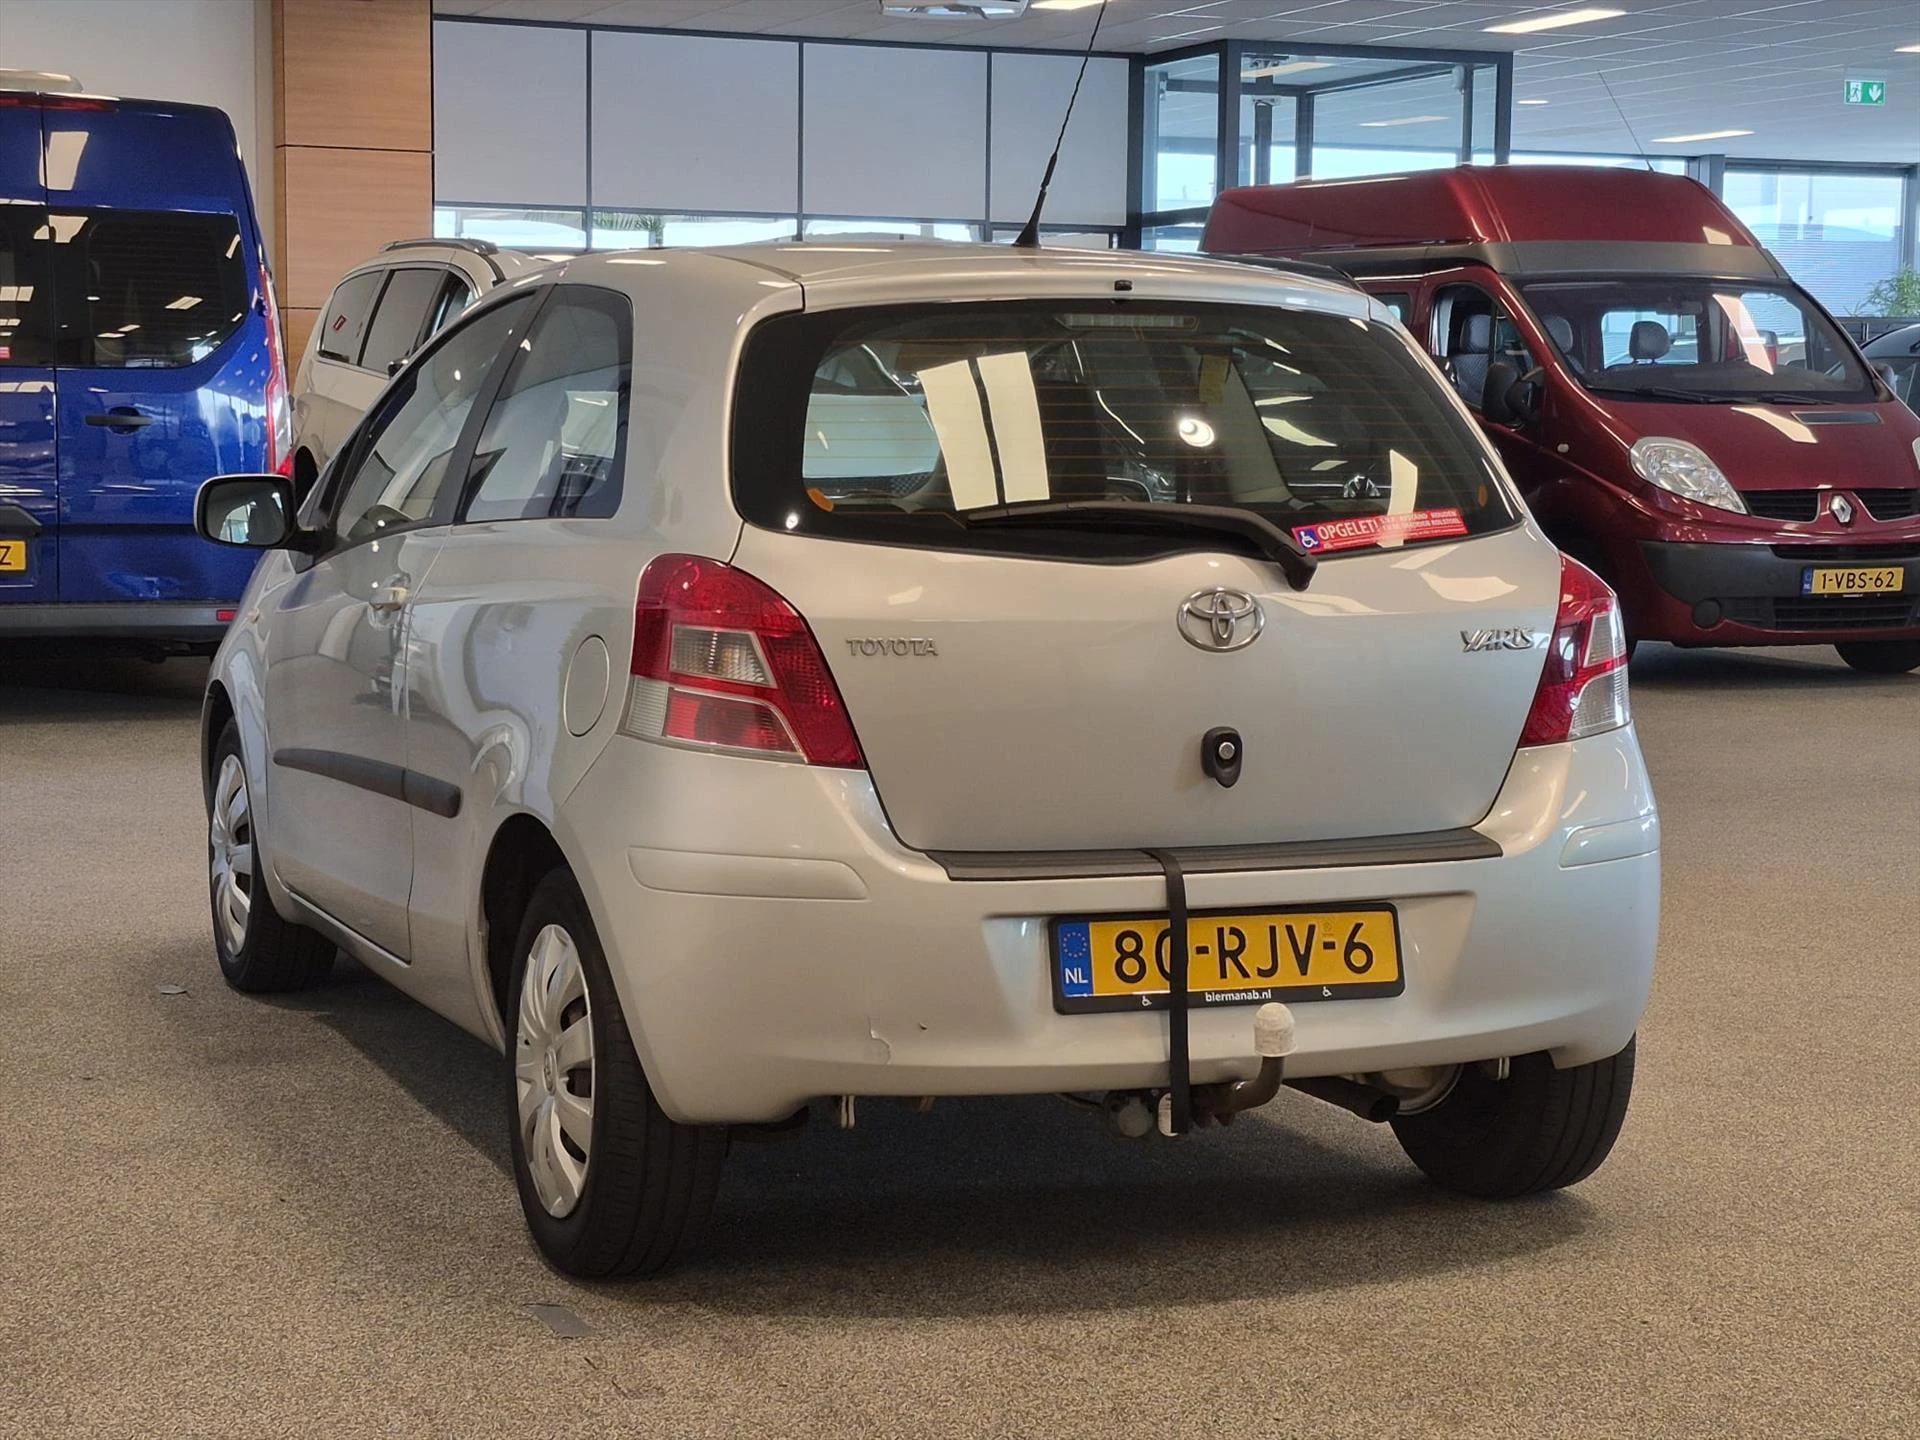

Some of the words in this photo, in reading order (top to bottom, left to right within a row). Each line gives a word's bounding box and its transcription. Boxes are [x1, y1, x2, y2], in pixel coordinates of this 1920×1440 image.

[1317, 519, 1380, 540] OPGELET!
[1822, 571, 1895, 589] 1-VBS-62
[845, 637, 939, 656] TOYOTA
[1460, 626, 1534, 653] YARIS
[1064, 967, 1089, 984] NL
[1205, 988, 1272, 1003] biermanab.nl
